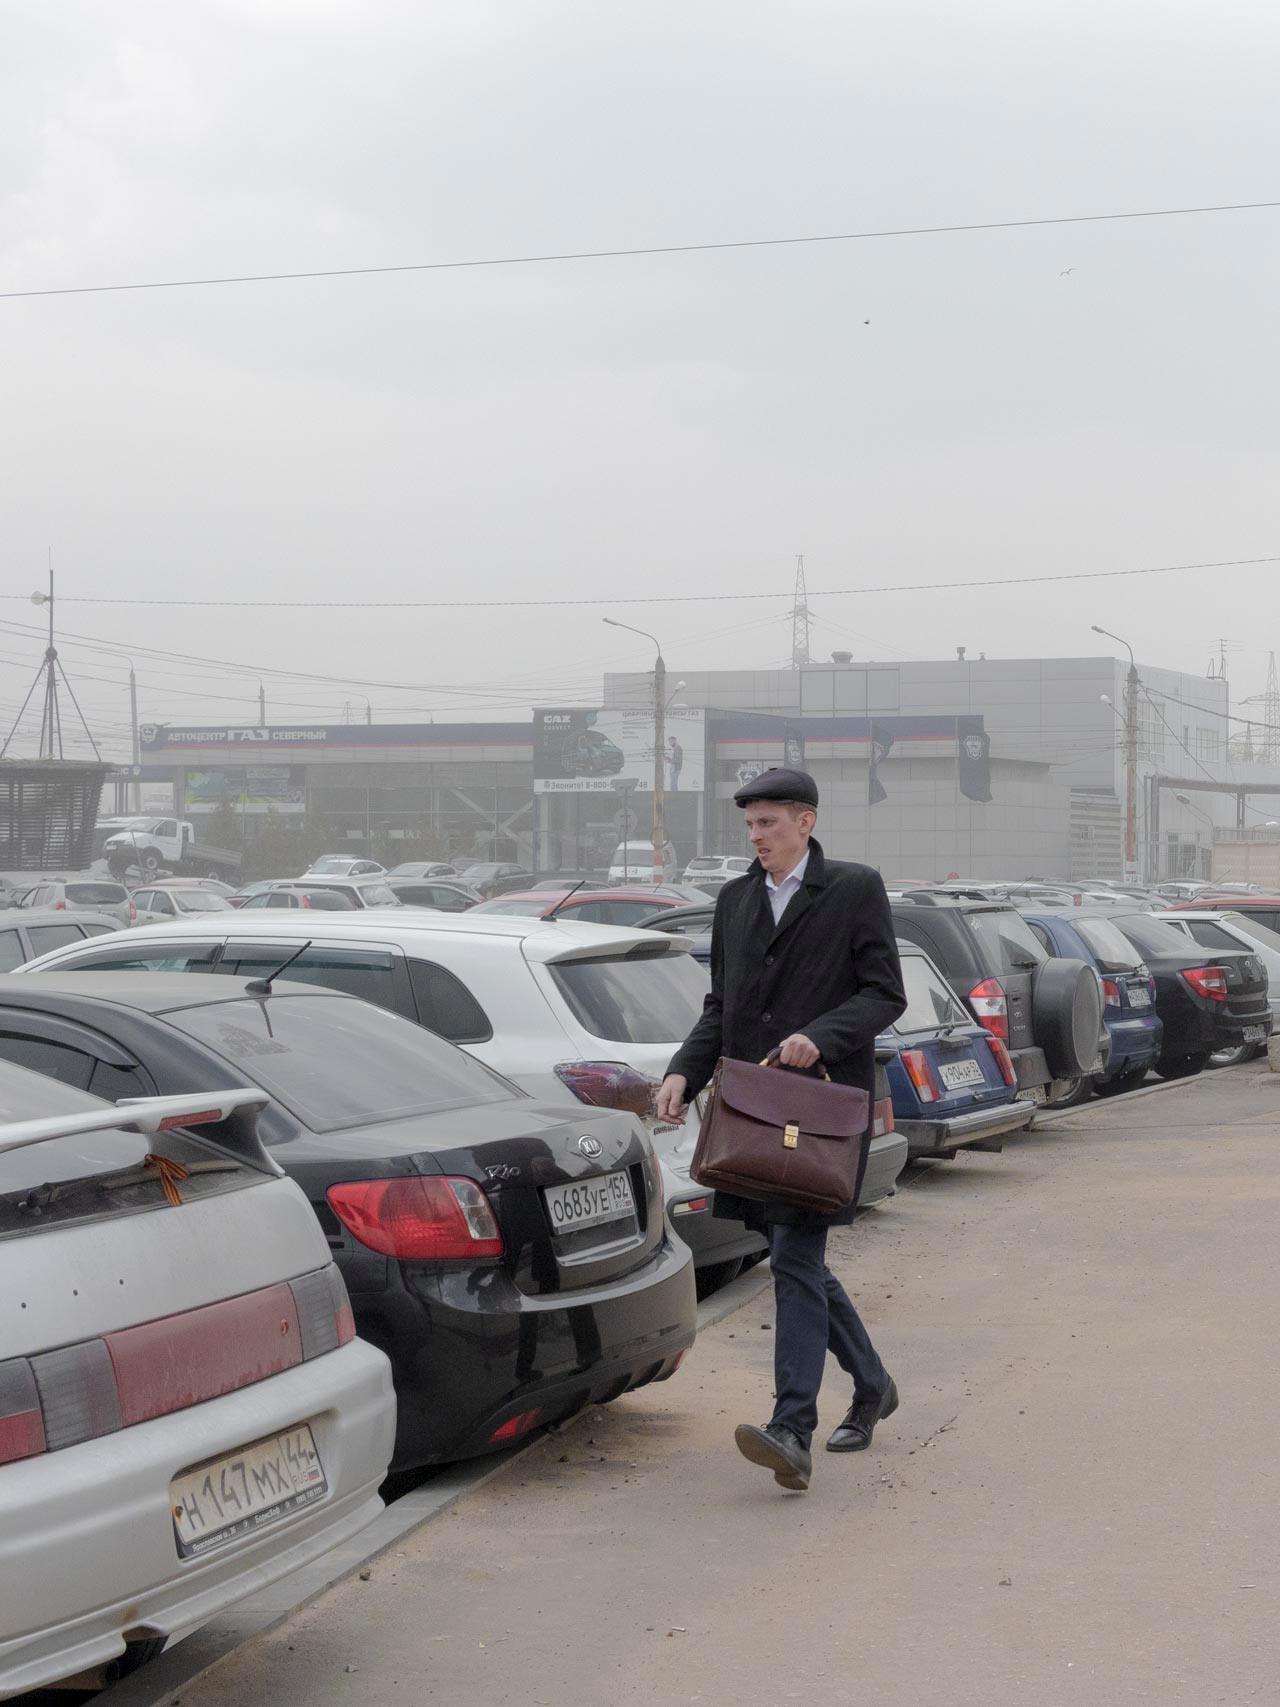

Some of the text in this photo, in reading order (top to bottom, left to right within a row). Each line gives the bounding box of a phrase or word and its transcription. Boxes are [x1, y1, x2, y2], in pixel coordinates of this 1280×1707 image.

[543, 715, 571, 723] GAZ
[168, 729, 327, 743] АВТОЦЕНТР ГАЗ СЕВЕРНЫЙ
[582, 1139, 600, 1155] KIA
[485, 1163, 521, 1180] Rio
[608, 1175, 629, 1202] 152
[614, 1198, 626, 1209] RUS
[286, 1433, 311, 1469] 44
[292, 1470, 308, 1484] RUS
